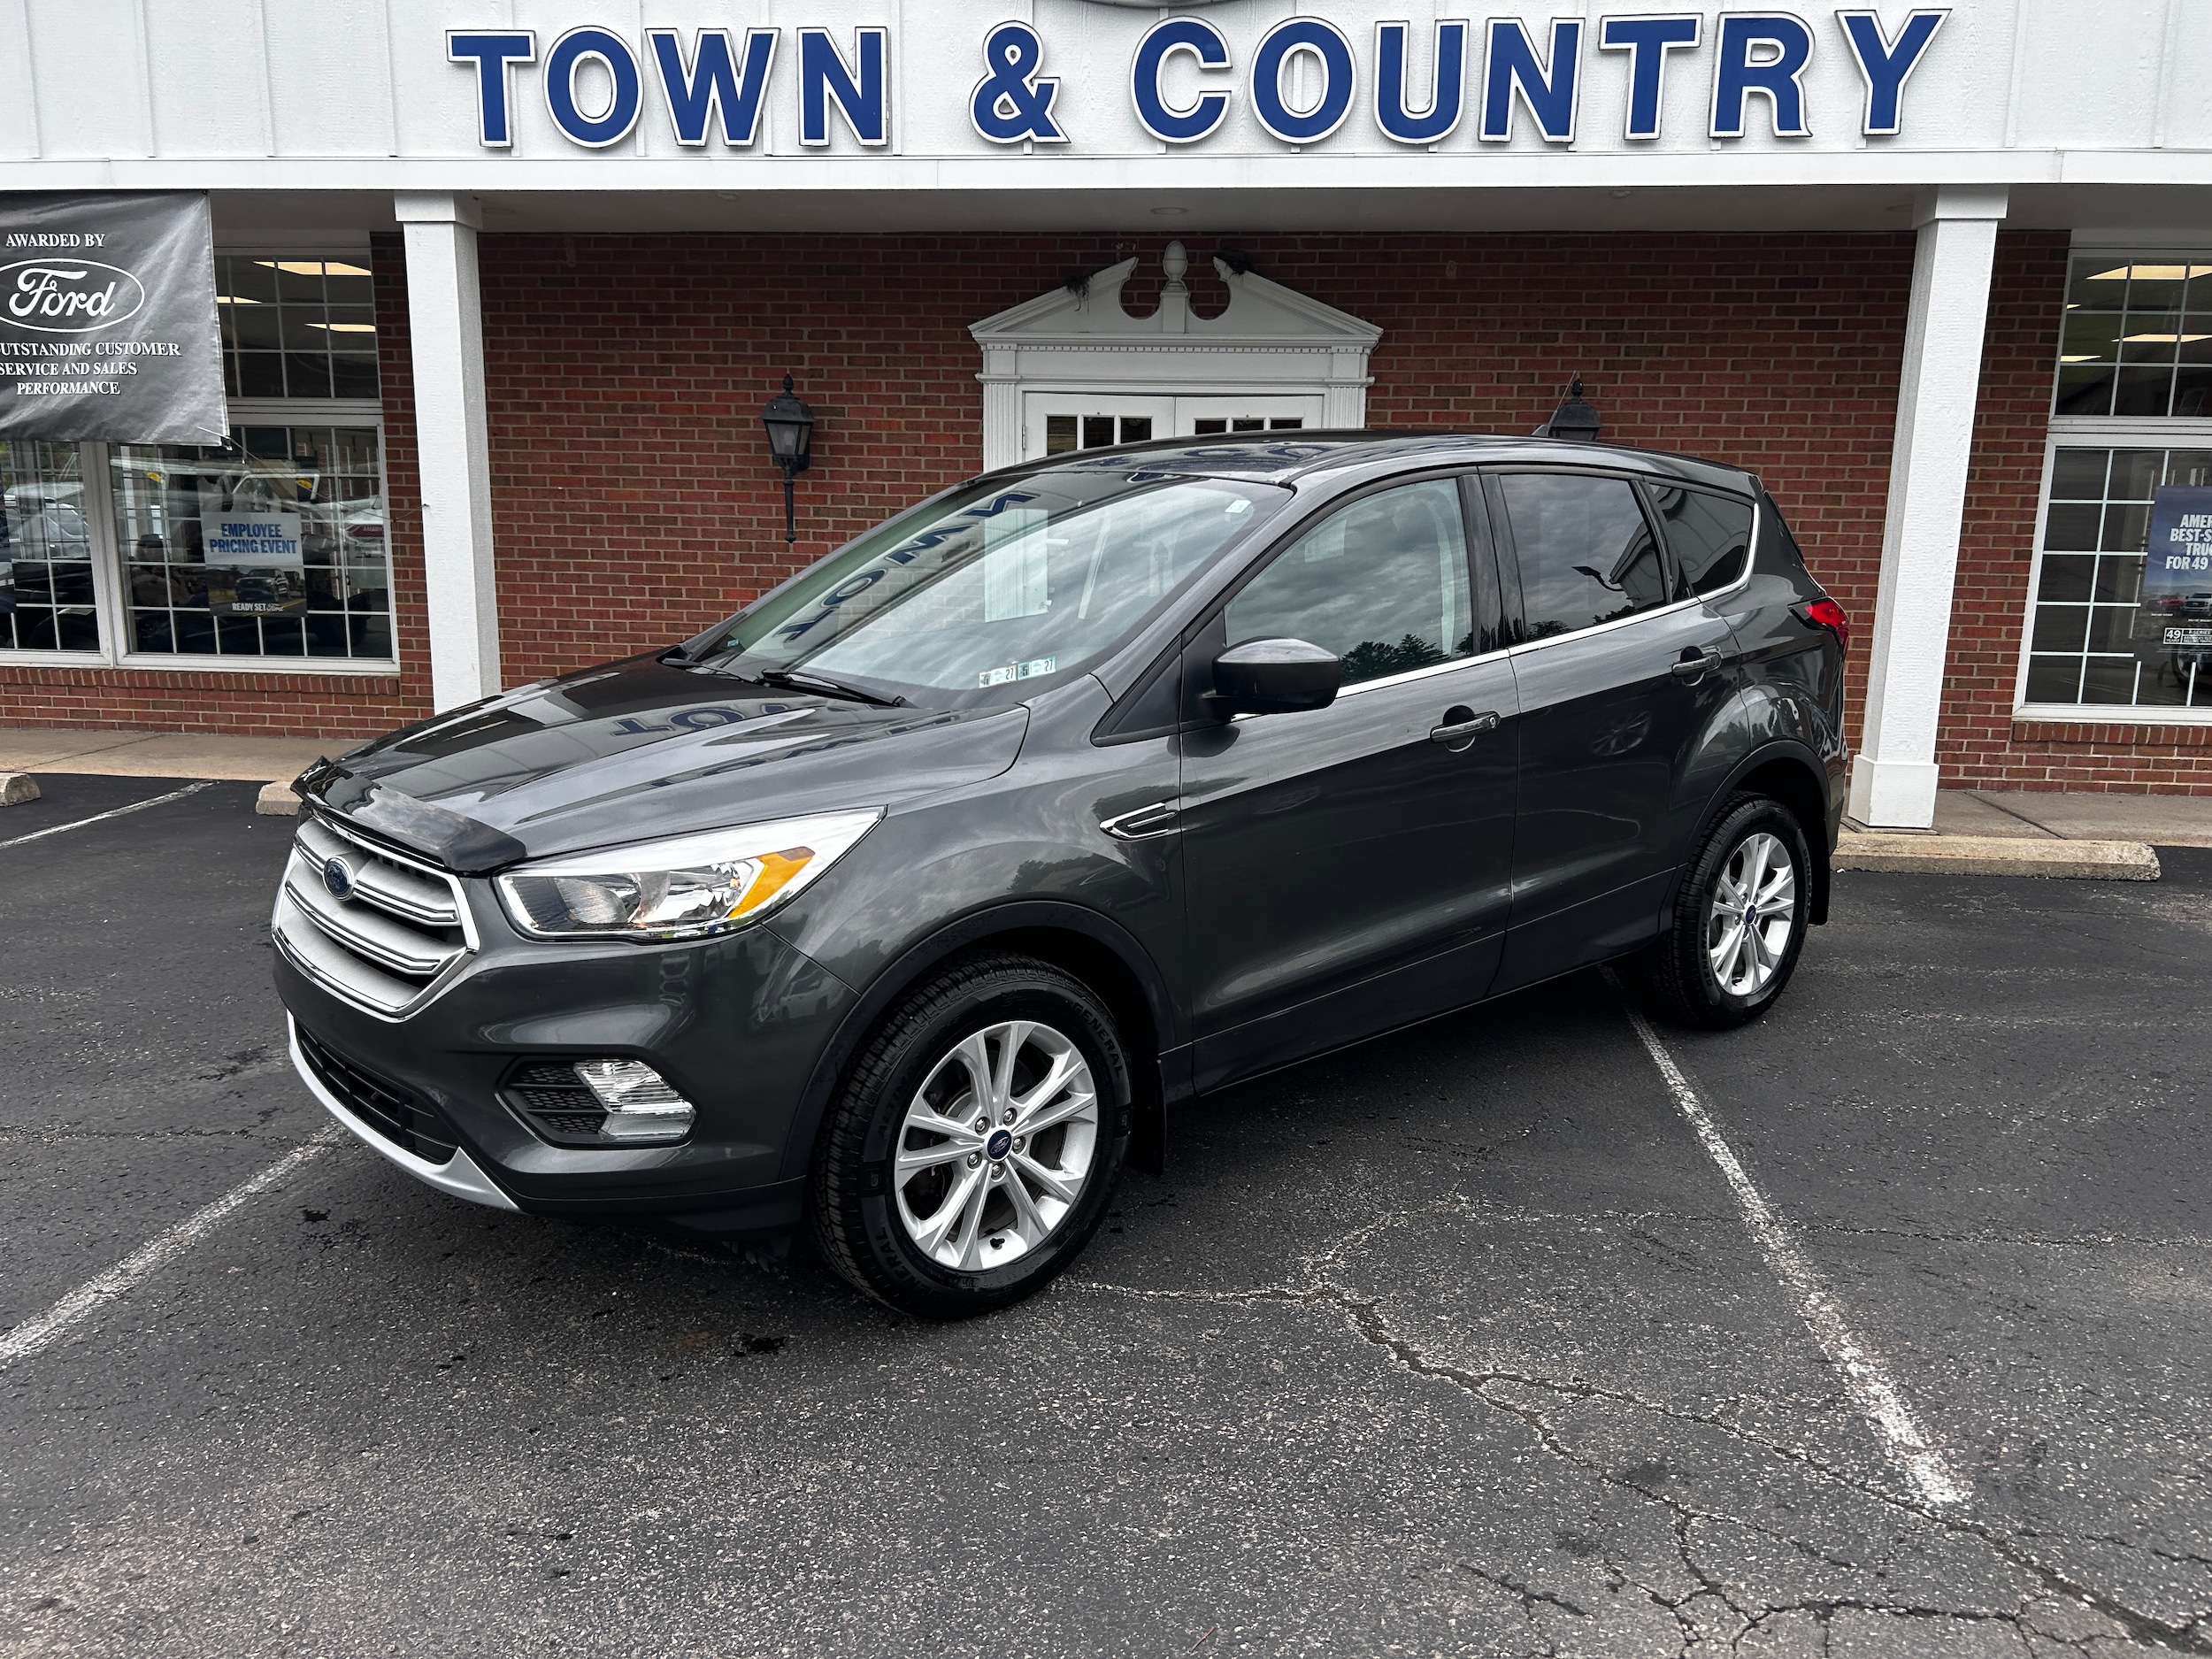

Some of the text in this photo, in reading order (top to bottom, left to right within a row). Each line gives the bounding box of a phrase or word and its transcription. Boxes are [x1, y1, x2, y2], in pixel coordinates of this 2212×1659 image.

[446, 9, 1950, 149] TOWN & COUNTRY
[6, 234, 105, 247] AWARDED BY
[9, 268, 116, 316] Ford
[0, 342, 182, 357] UTSTANDING CUSTOMER
[0, 362, 138, 376] SERVICE AND SALES
[16, 381, 121, 396] PERFORMANCE
[220, 523, 282, 538] EMPLOYEE
[210, 539, 297, 554] PRICING EVENT
[2165, 556, 2209, 571] FOR 49
[232, 603, 253, 611] READY
[254, 603, 266, 611] SET
[2167, 629, 2181, 639] 49
